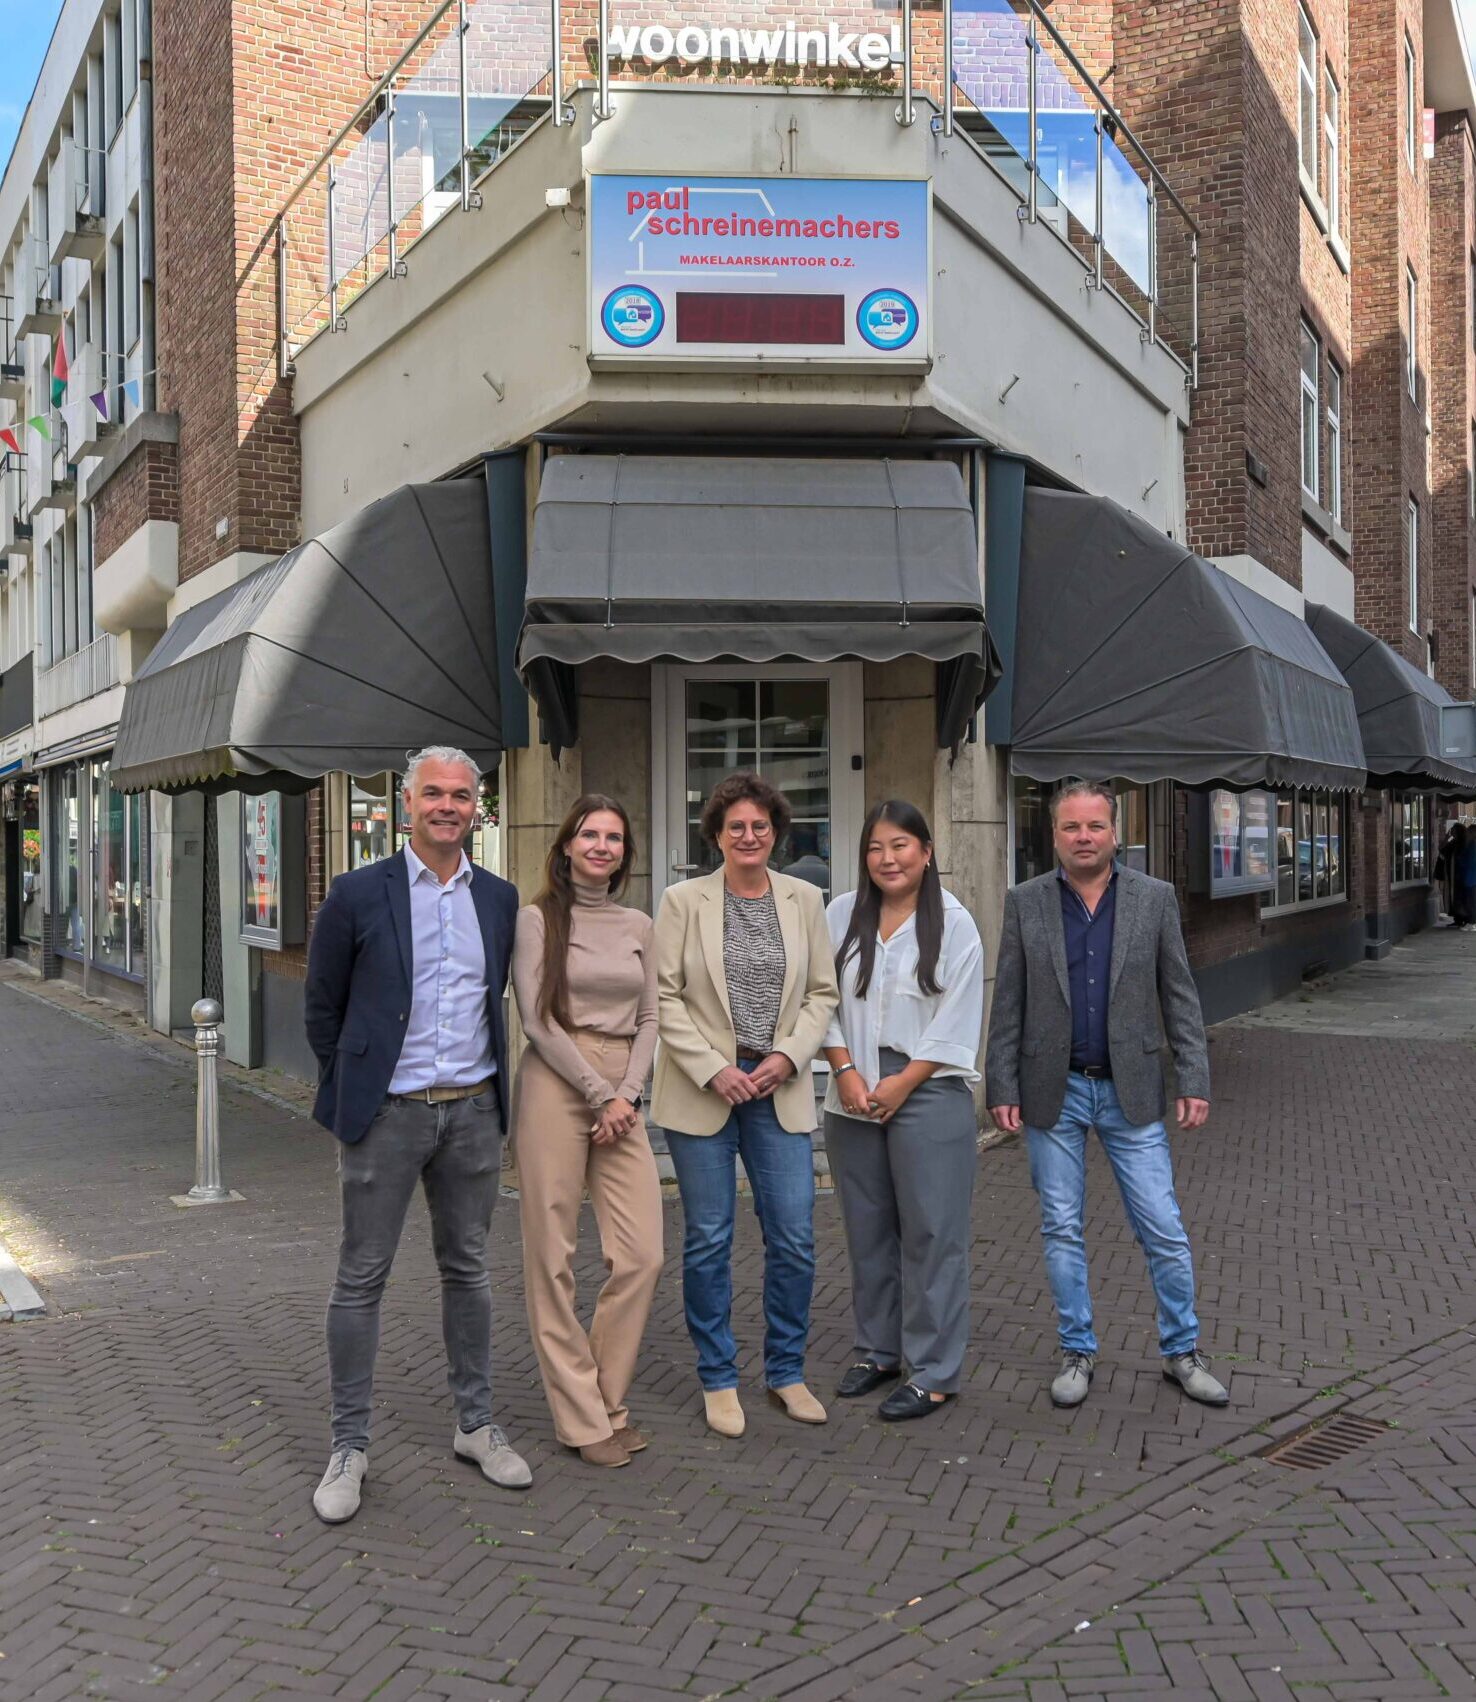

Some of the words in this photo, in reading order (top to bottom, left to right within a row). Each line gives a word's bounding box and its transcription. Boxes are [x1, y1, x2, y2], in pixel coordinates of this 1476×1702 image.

[597, 20, 901, 70] woonwinkel
[627, 186, 689, 214] paul
[647, 212, 900, 239] schreinemachers
[679, 255, 826, 267] MAKELAARSKANTOOR
[830, 257, 855, 267] O.Z.
